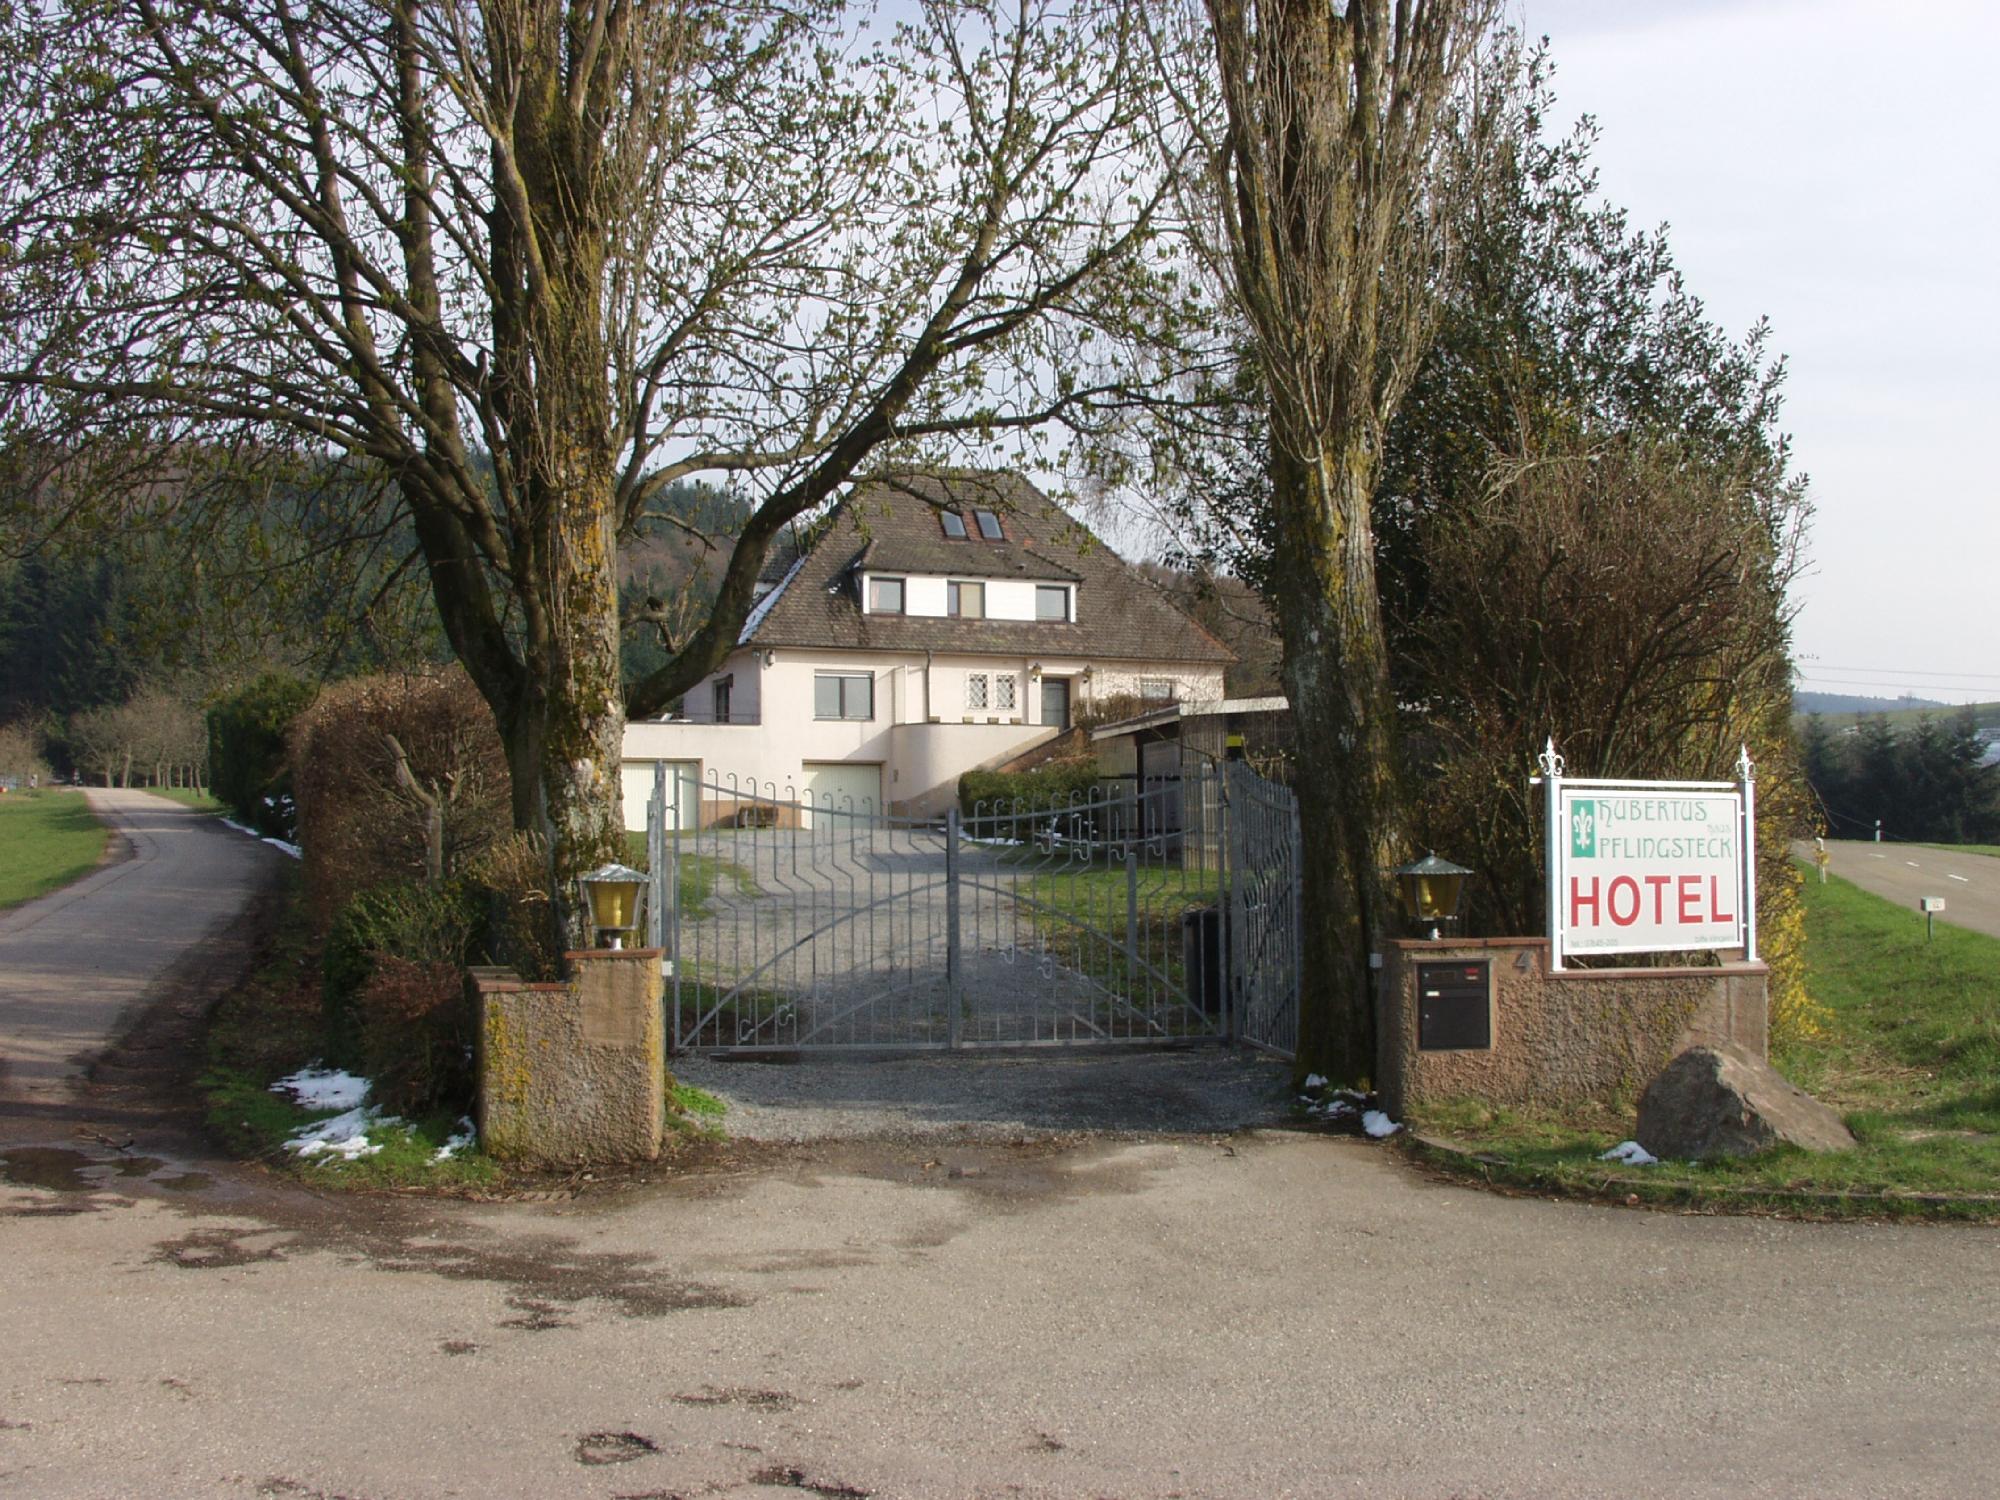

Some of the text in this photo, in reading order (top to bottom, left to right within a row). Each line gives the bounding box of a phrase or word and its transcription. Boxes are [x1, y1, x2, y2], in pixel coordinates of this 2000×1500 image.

[1597, 799, 1708, 828] HUBERTUS
[1600, 837, 1733, 859] PFLINGSTECK
[1570, 875, 1734, 928] HOTEL
